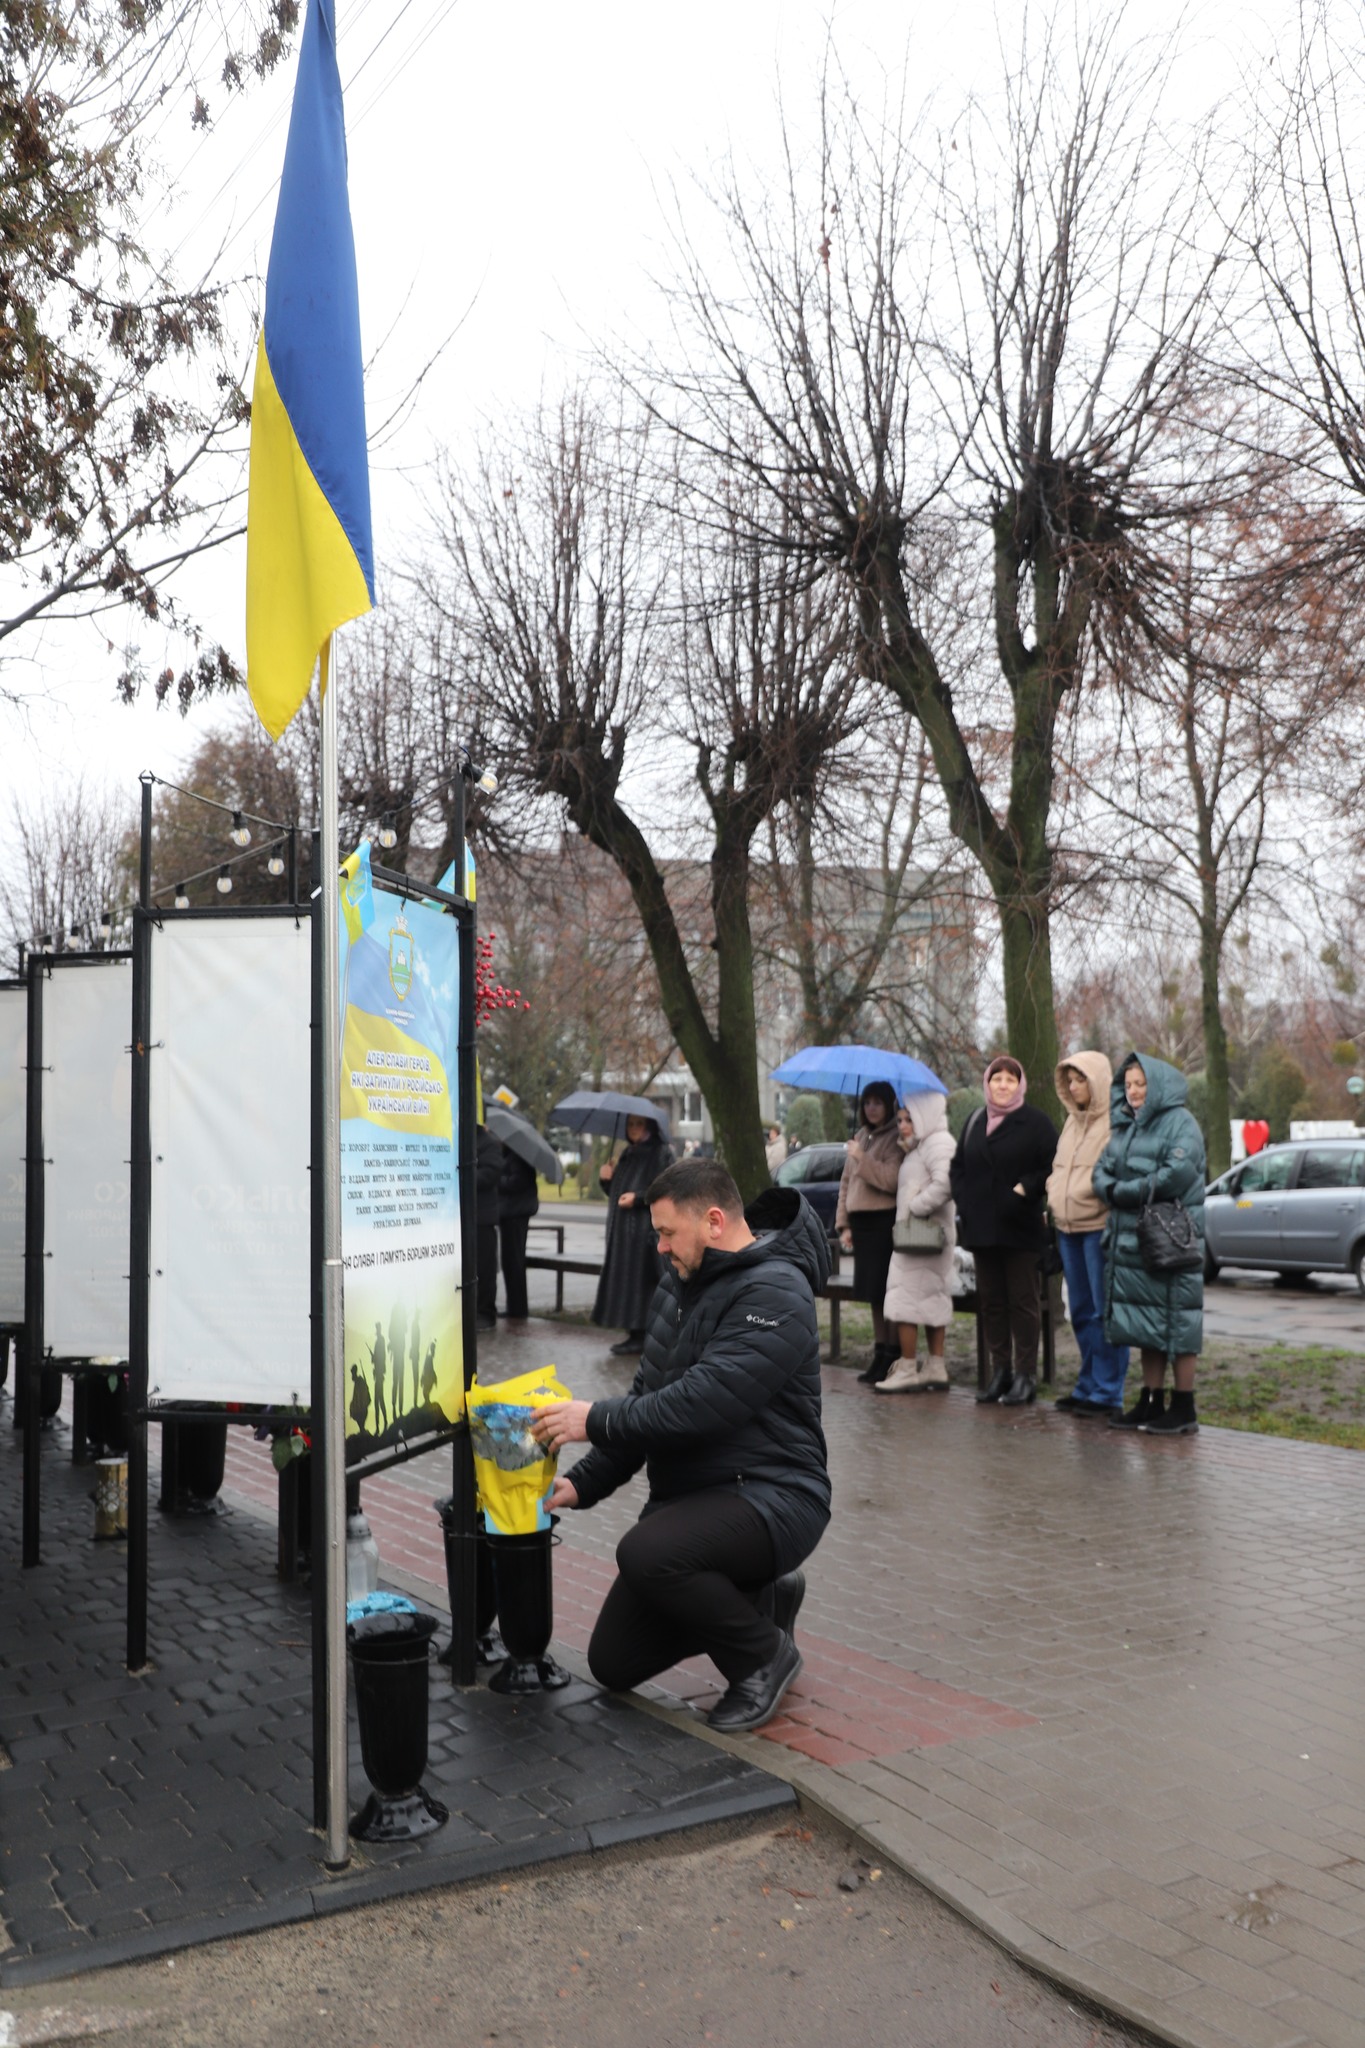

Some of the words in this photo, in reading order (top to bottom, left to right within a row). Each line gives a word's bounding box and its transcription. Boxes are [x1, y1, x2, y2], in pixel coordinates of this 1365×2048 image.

[366, 1052, 384, 1065] АЛЕЯ
[386, 1053, 408, 1069] СЛАВИ
[351, 1074, 363, 1087] ЯКІ
[366, 1075, 400, 1091] ЗАГИНУЛИ
[368, 1096, 412, 1112] УКРАЇНСЬКІЙ
[353, 1252, 375, 1268] СЛАВА
[407, 1246, 429, 1262] БОРЦЯМ
[430, 1244, 438, 1258] ЗА
